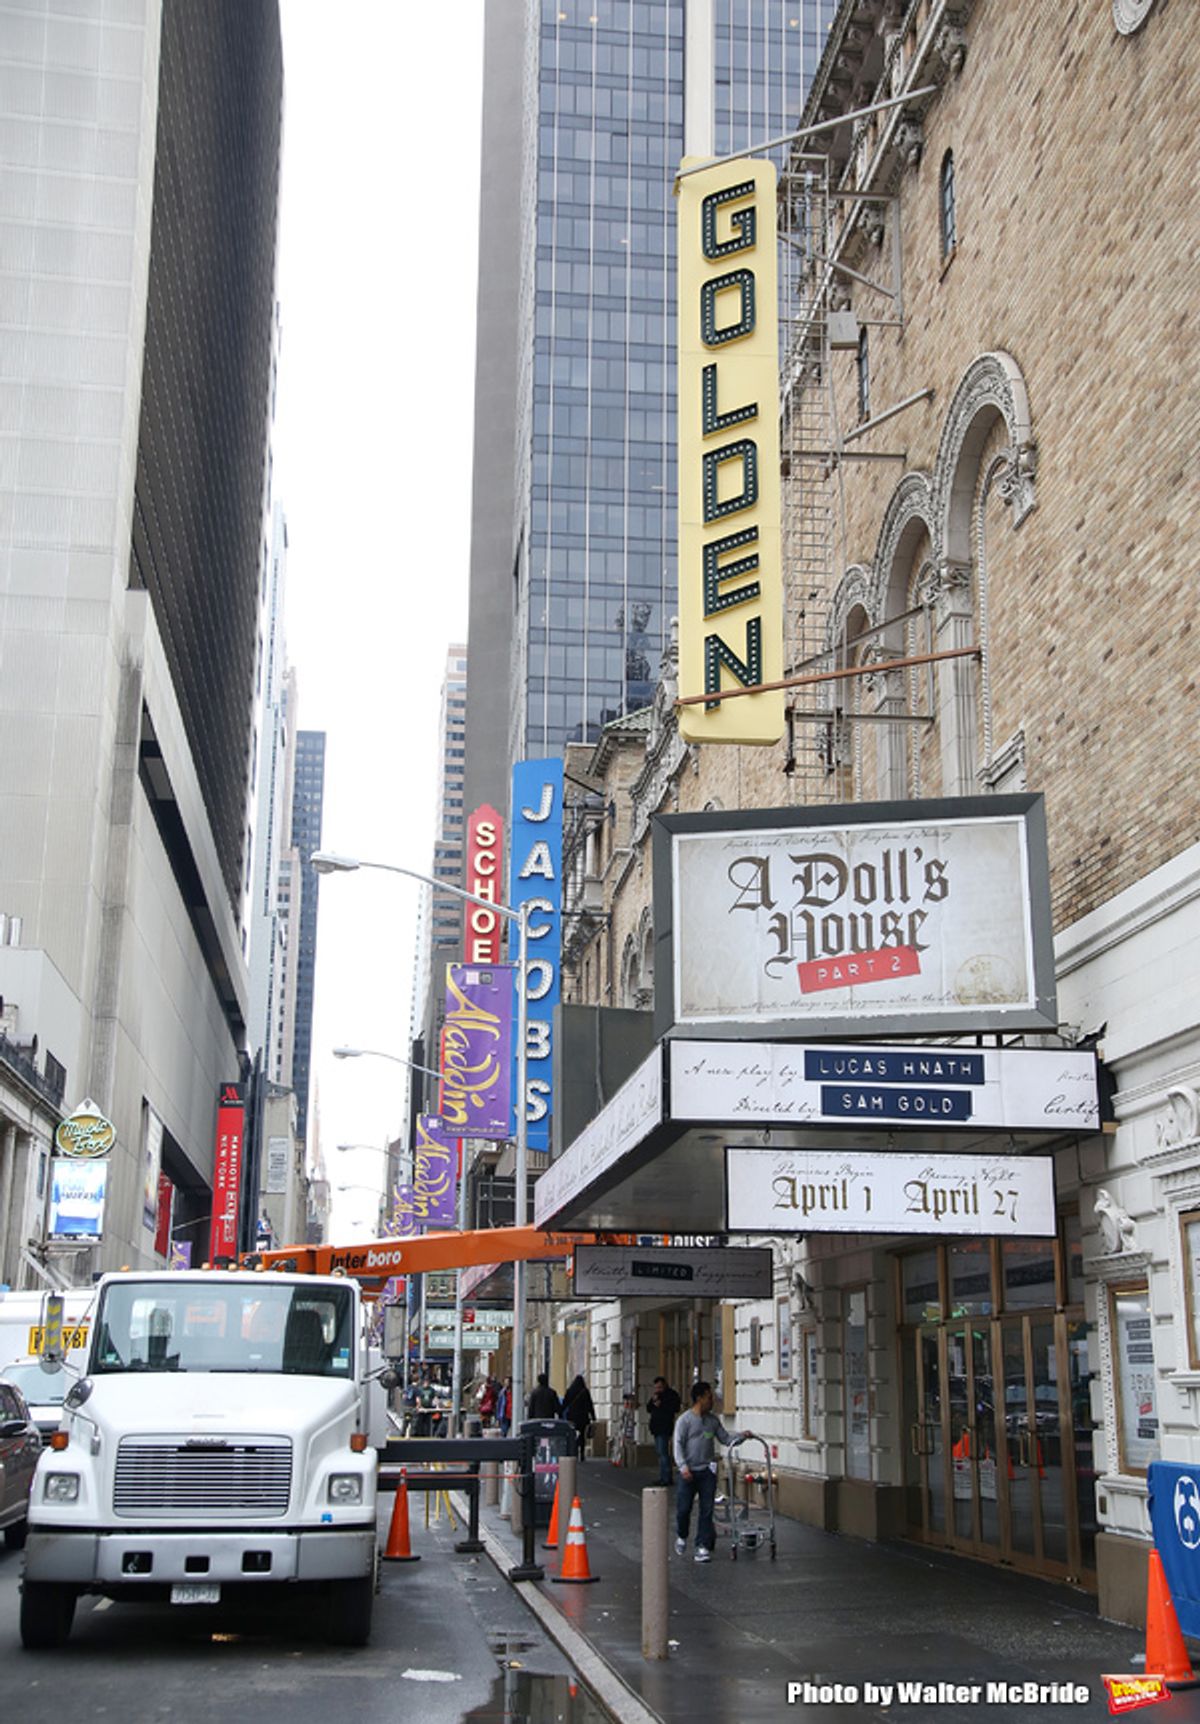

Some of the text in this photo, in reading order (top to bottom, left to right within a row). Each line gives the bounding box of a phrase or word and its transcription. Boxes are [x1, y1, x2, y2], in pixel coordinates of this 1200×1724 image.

[701, 178, 762, 714] GOLDEN
[728, 846, 949, 914] A Doll's
[515, 783, 556, 1122] JACOBS
[764, 908, 931, 979] House
[817, 956, 902, 983] PART 2
[443, 962, 501, 1125] Aladdin
[736, 1064, 773, 1087] play
[779, 1065, 798, 1087] by
[820, 1056, 972, 1075] LUCAS HNATH
[732, 1096, 816, 1121] Directed by
[842, 1093, 952, 1114] SAM GOLD
[414, 1113, 451, 1217] Aladdin
[772, 1175, 872, 1217] April 1
[904, 1180, 1019, 1222] April 27
[330, 1250, 402, 1271] Interboro
[637, 1265, 688, 1277] LIMITED
